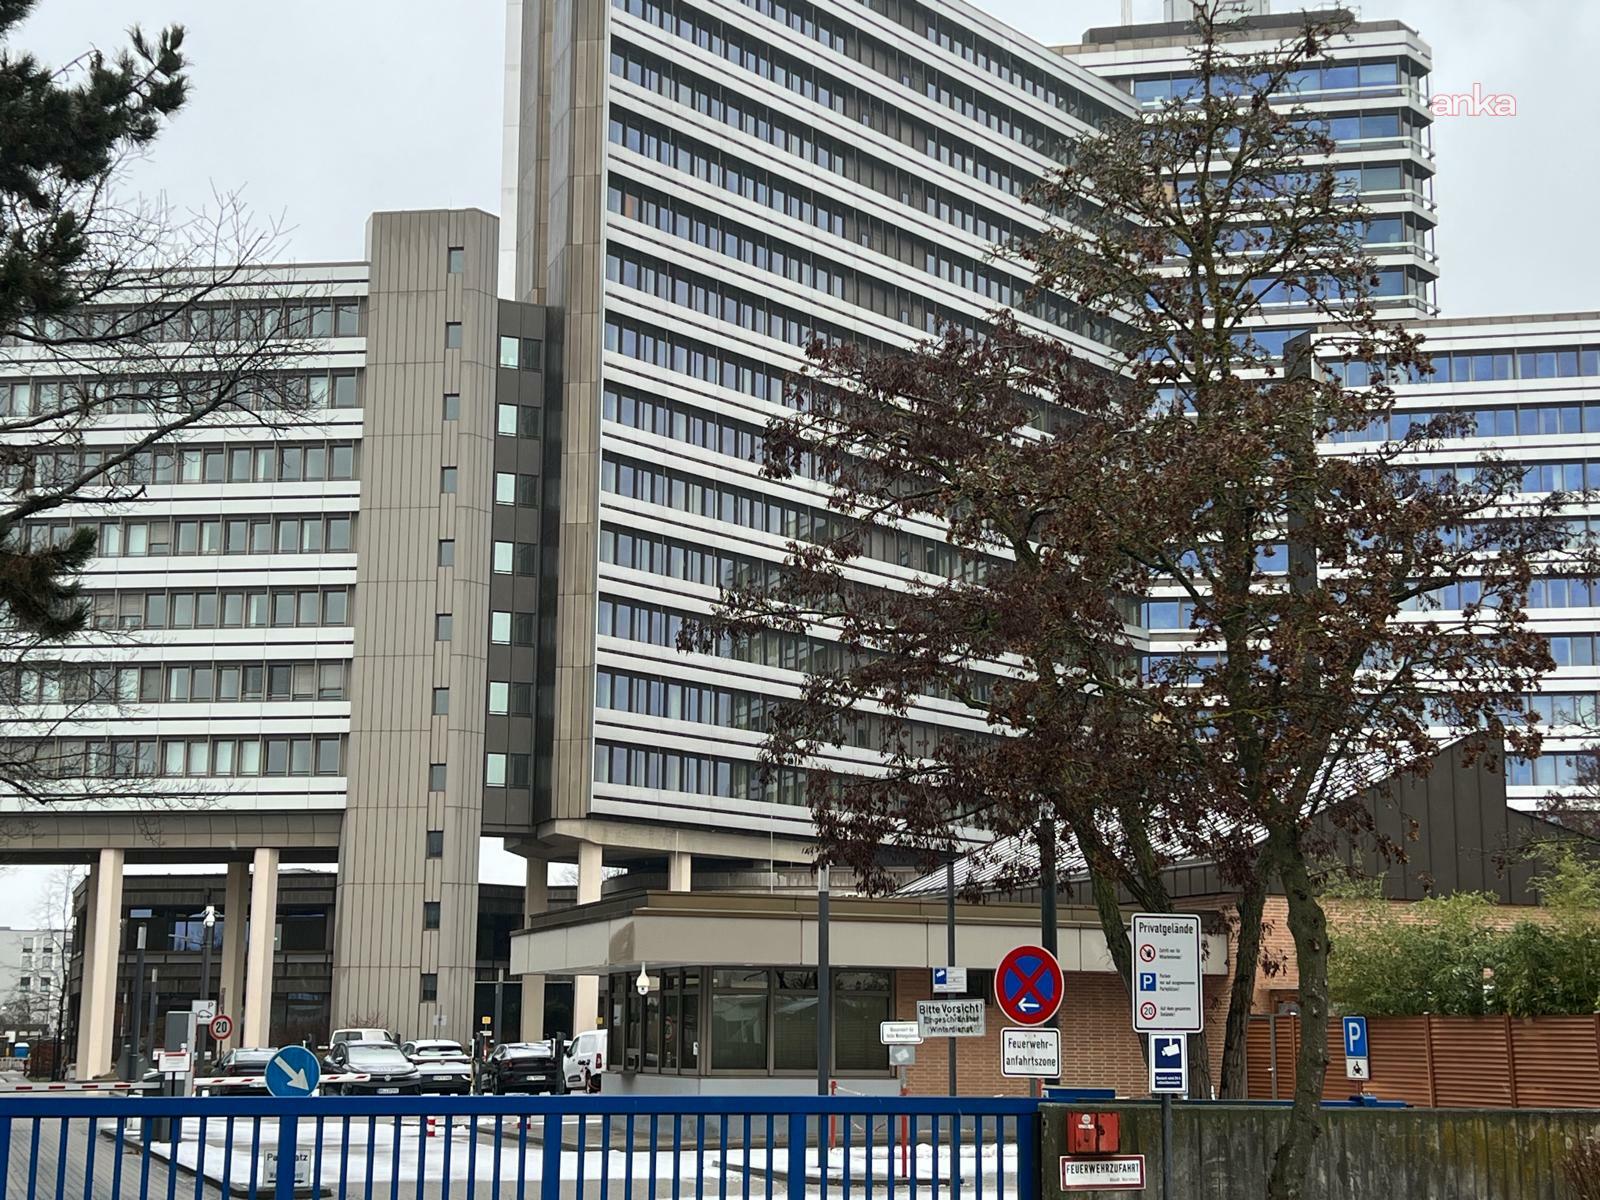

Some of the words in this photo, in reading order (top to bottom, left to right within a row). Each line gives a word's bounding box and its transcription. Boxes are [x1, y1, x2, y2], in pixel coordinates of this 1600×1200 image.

[1139, 921, 1194, 936] Privatgelände
[1143, 974, 1153, 990] P
[919, 1004, 941, 1015] Bitte
[1143, 1006, 1153, 1016] 20
[216, 1021, 227, 1033] 20
[1008, 1037, 1053, 1049] Feuerwehr-
[1348, 1022, 1361, 1052] P
[1006, 1055, 1056, 1067] anfahrtszone
[1067, 1162, 1139, 1175] FEUERWEHRZUFAHRT
